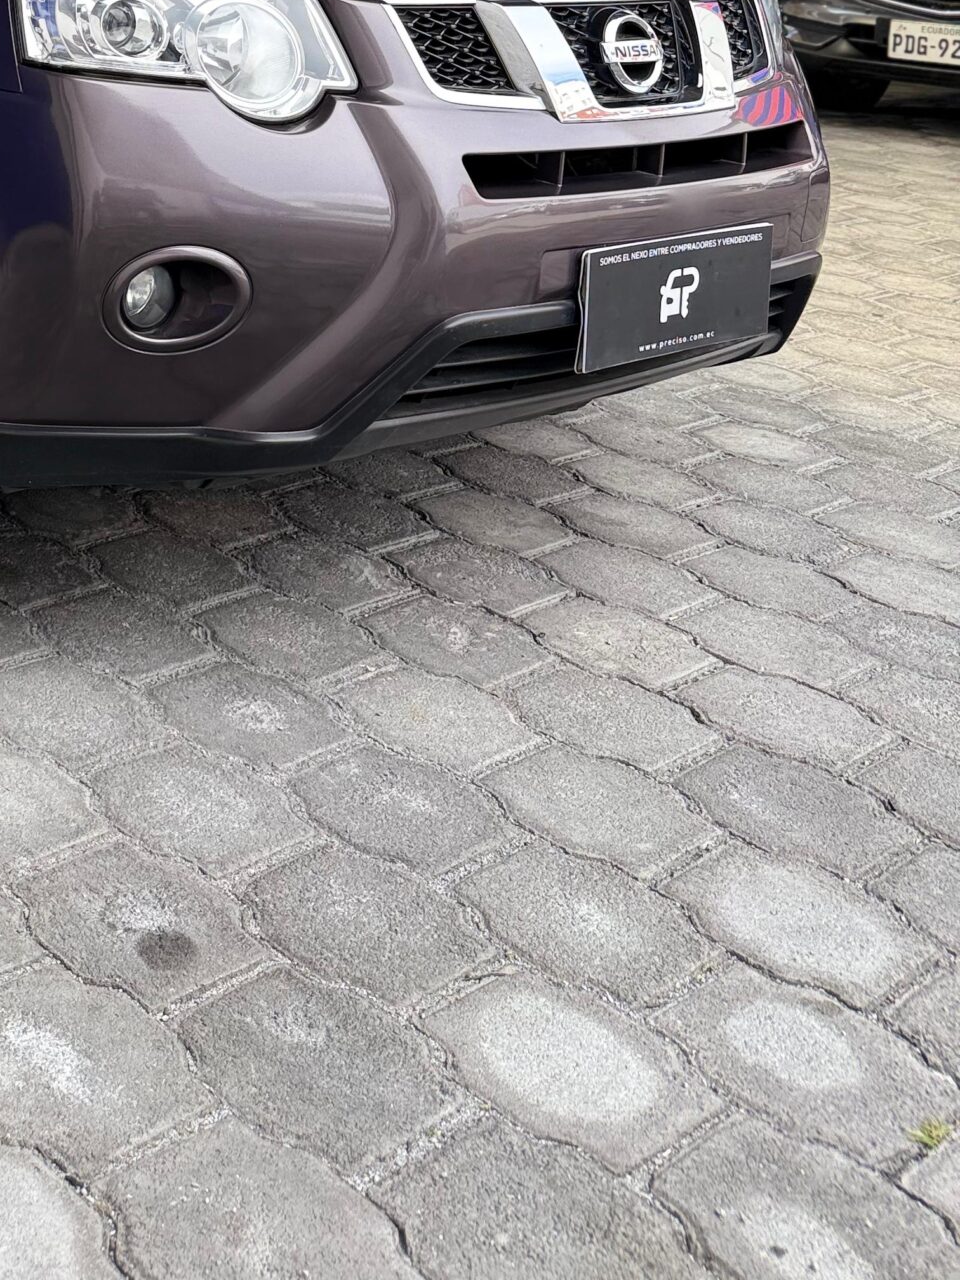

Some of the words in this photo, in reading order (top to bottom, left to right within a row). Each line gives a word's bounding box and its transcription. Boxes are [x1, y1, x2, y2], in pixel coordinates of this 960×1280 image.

[614, 44, 662, 58] NISSAN
[599, 253, 622, 266] SOMOS
[622, 252, 630, 262] EL
[631, 249, 648, 260] NEXO
[649, 246, 669, 257] ENTRE
[669, 240, 717, 254] COMPRADORES
[717, 238, 723, 247] Y
[722, 233, 763, 246] VENDEDORES
[639, 330, 715, 353] www.preciso.com.ec
